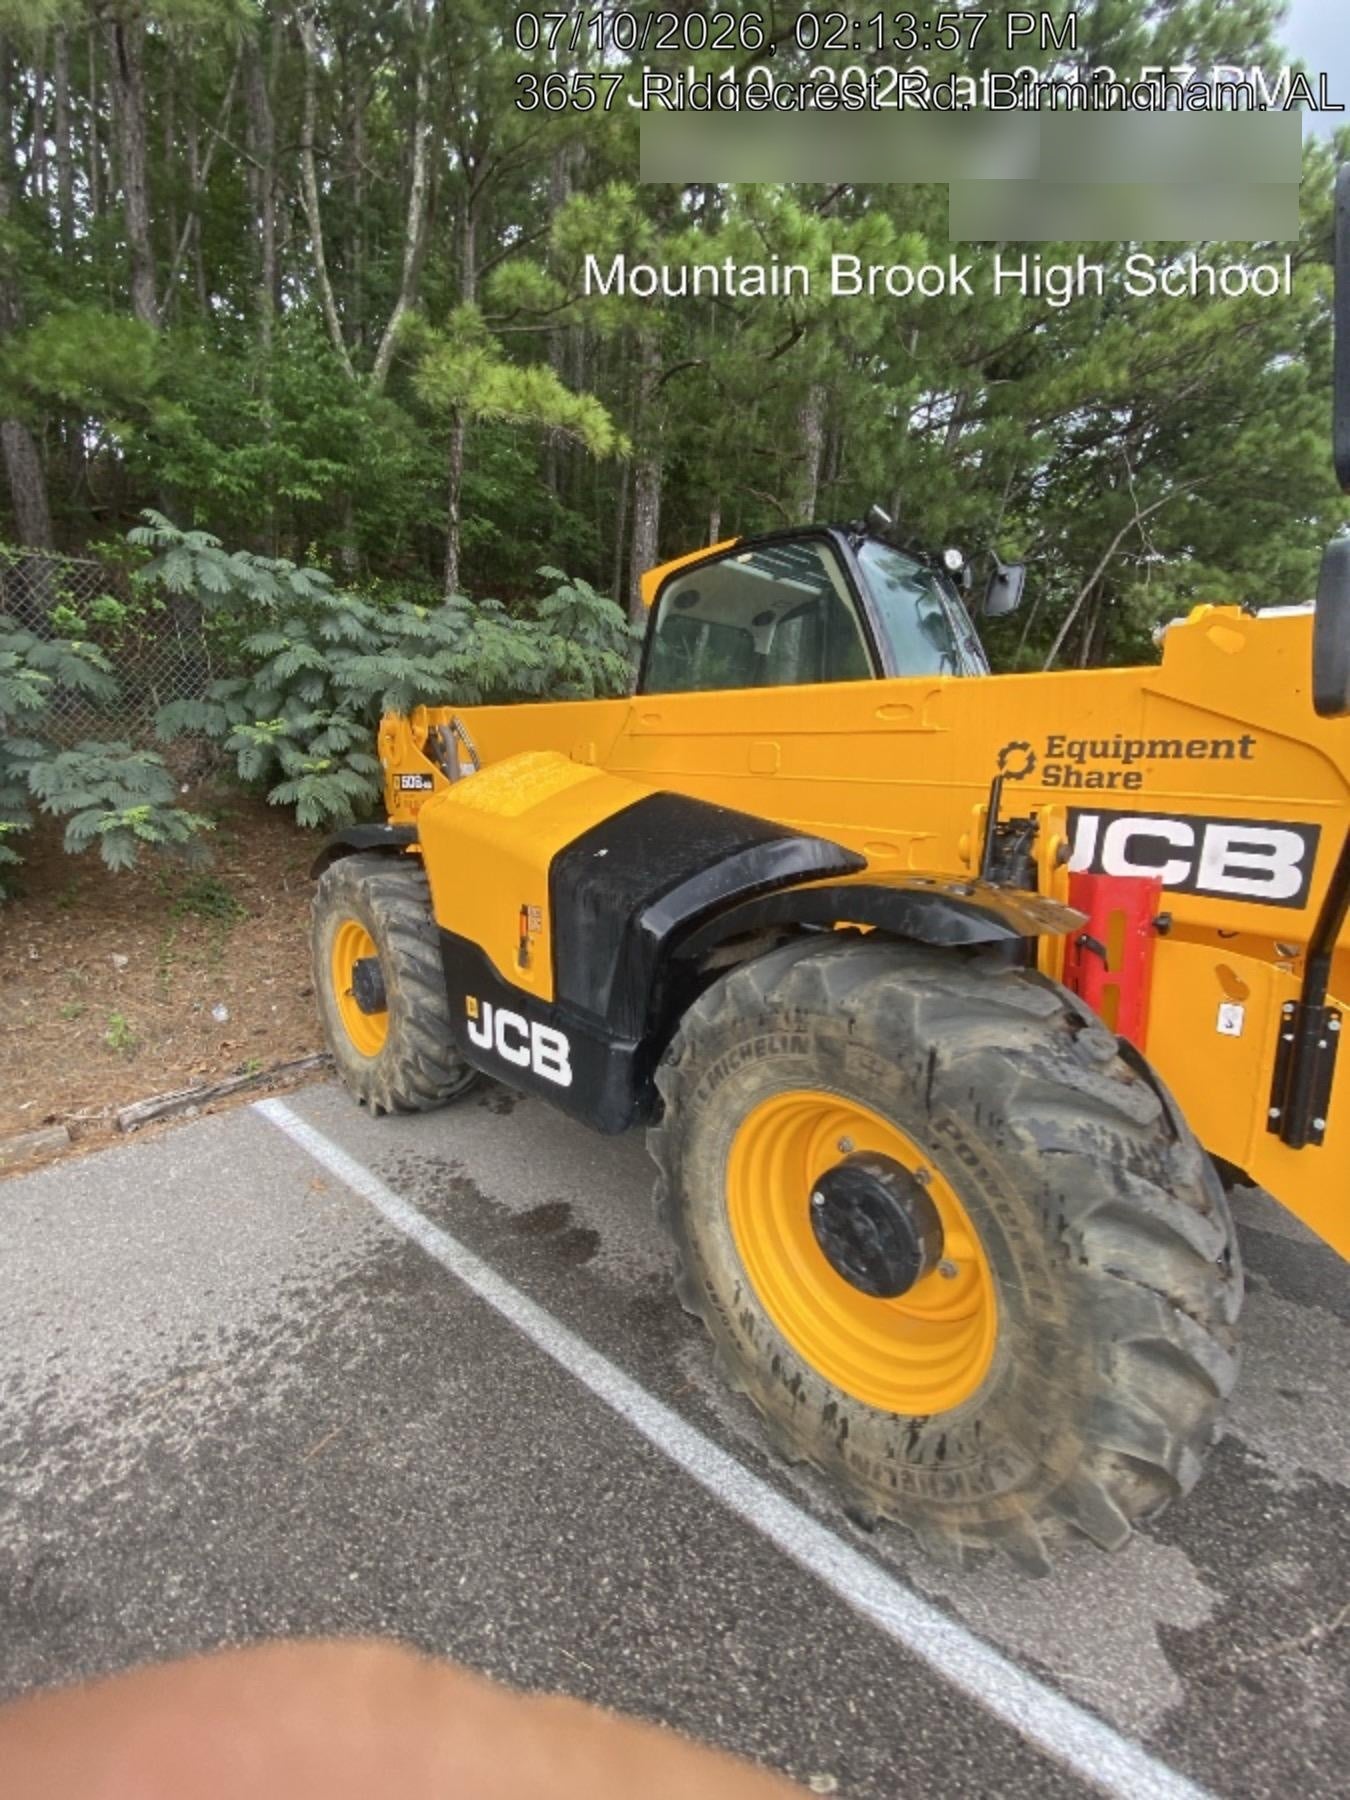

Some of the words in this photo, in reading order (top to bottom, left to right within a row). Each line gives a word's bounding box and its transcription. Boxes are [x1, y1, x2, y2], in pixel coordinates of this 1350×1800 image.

[1041, 764, 1144, 790] Share
[1043, 734, 1257, 764] Equipment
[1067, 814, 1306, 900] JCB
[466, 1000, 573, 1088] JCB
[706, 1033, 810, 1091] MICHELIN
